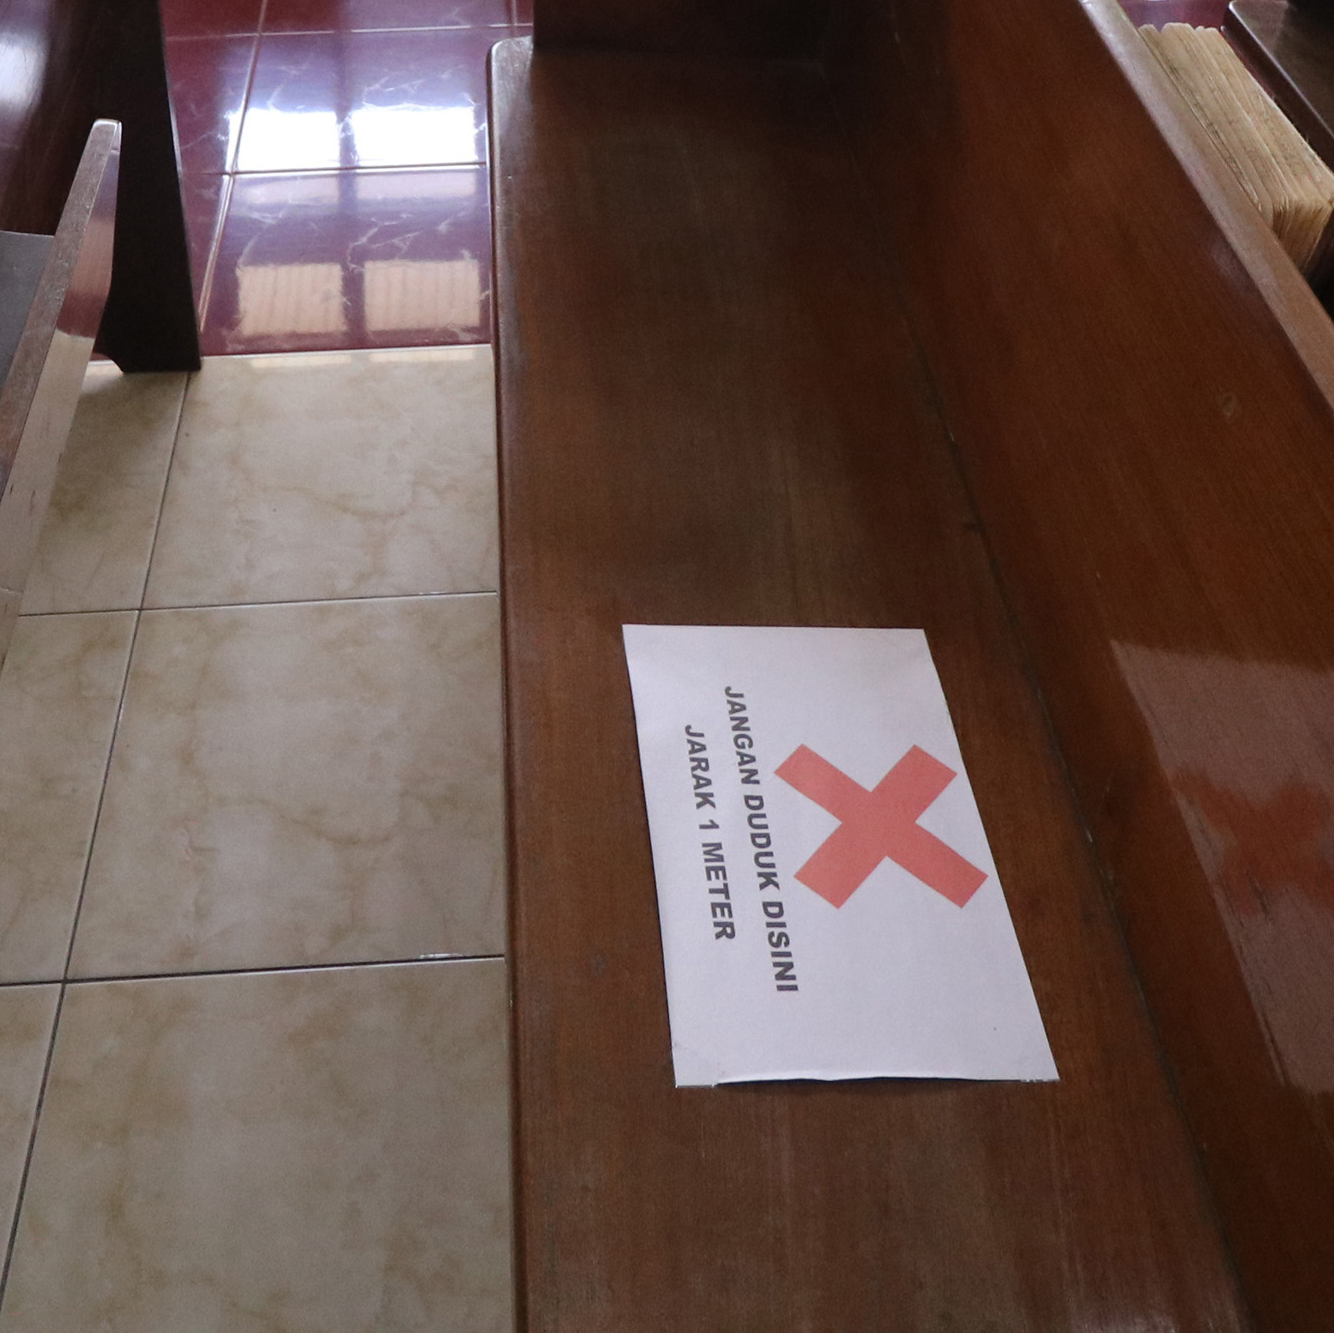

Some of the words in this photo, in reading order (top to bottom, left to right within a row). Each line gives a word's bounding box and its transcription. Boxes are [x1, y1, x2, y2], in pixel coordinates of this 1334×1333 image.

[684, 724, 716, 810] JARAK
[724, 686, 761, 785] JANGAN
[699, 819, 720, 830] 1
[743, 794, 780, 891] DUDUK
[701, 842, 736, 940] METER
[761, 901, 799, 992] DISINI
